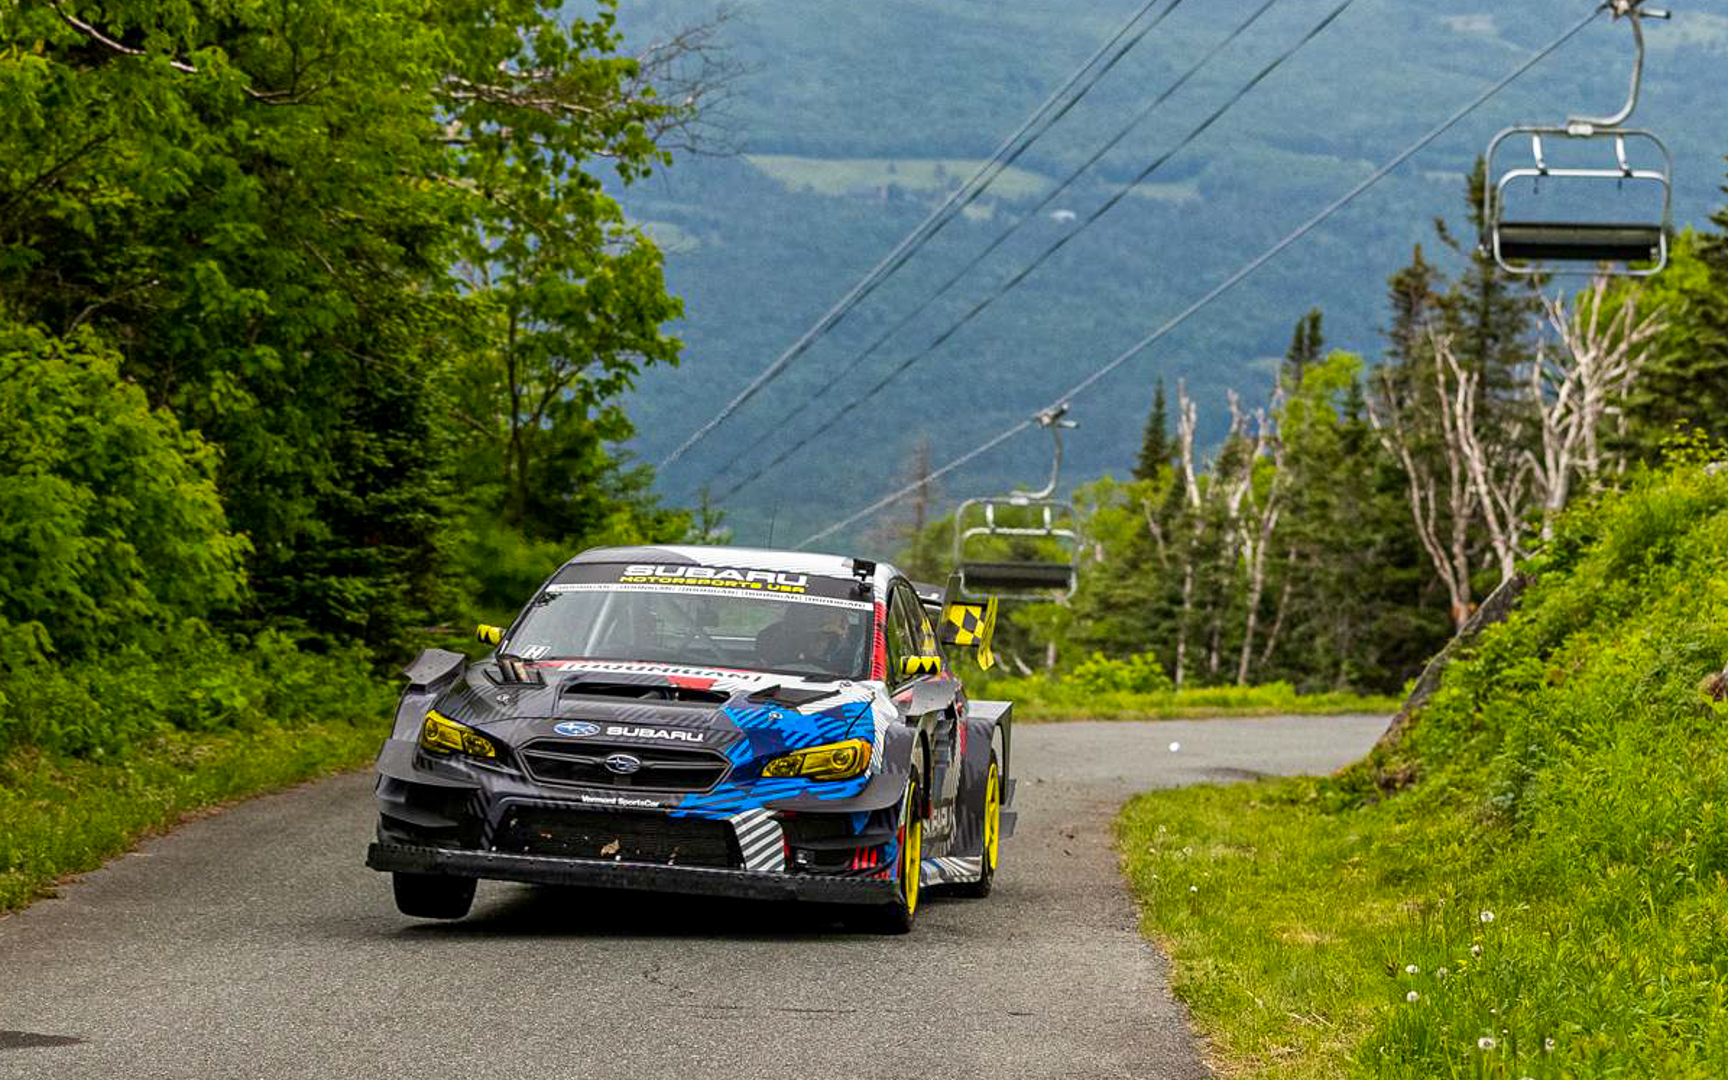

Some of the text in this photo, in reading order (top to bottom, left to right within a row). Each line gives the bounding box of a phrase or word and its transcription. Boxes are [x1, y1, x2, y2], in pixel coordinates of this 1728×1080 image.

[623, 565, 807, 586] SUBARU
[619, 576, 762, 589] MOTORSPORTS
[766, 582, 805, 594] USA
[606, 726, 704, 743] SUBARU
